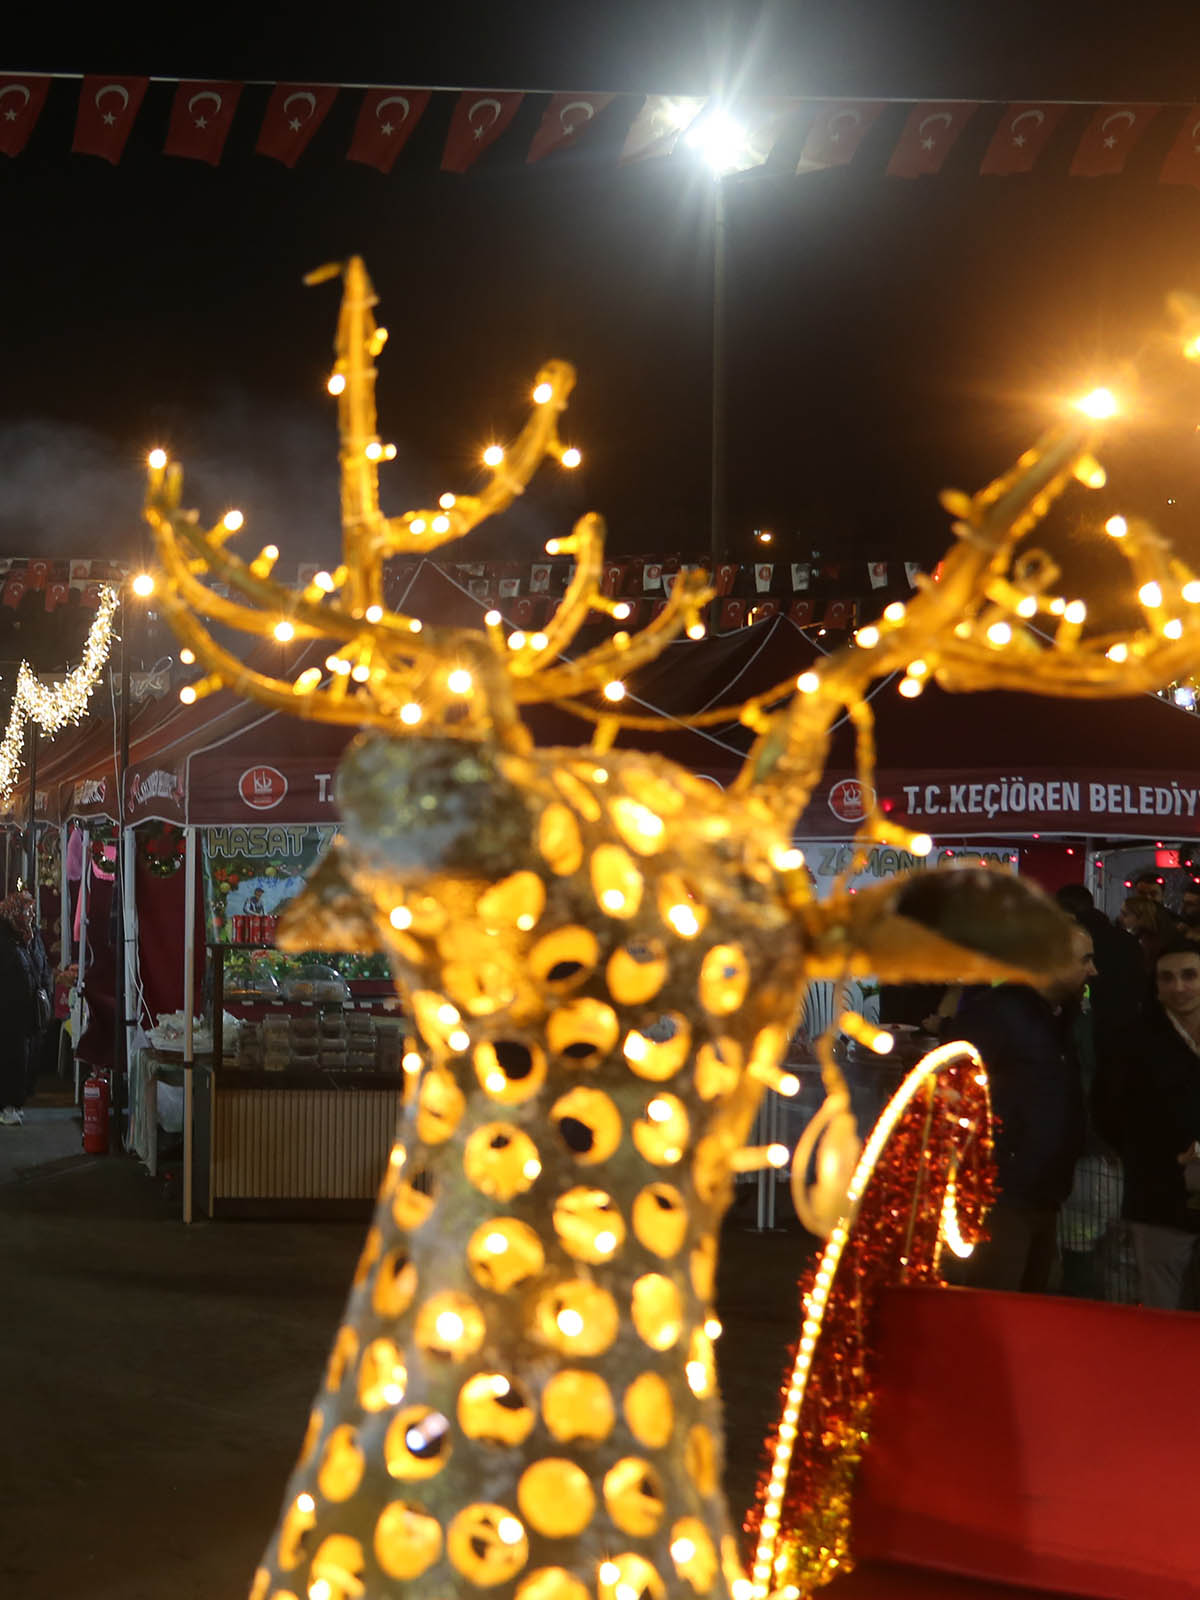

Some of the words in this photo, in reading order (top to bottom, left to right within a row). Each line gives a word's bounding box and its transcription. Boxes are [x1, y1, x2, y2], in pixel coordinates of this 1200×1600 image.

[903, 777, 1080, 818] T.C.KEÇİÖREN
[1089, 782, 1200, 817] BELEDİY
[208, 825, 309, 858] HASAT
